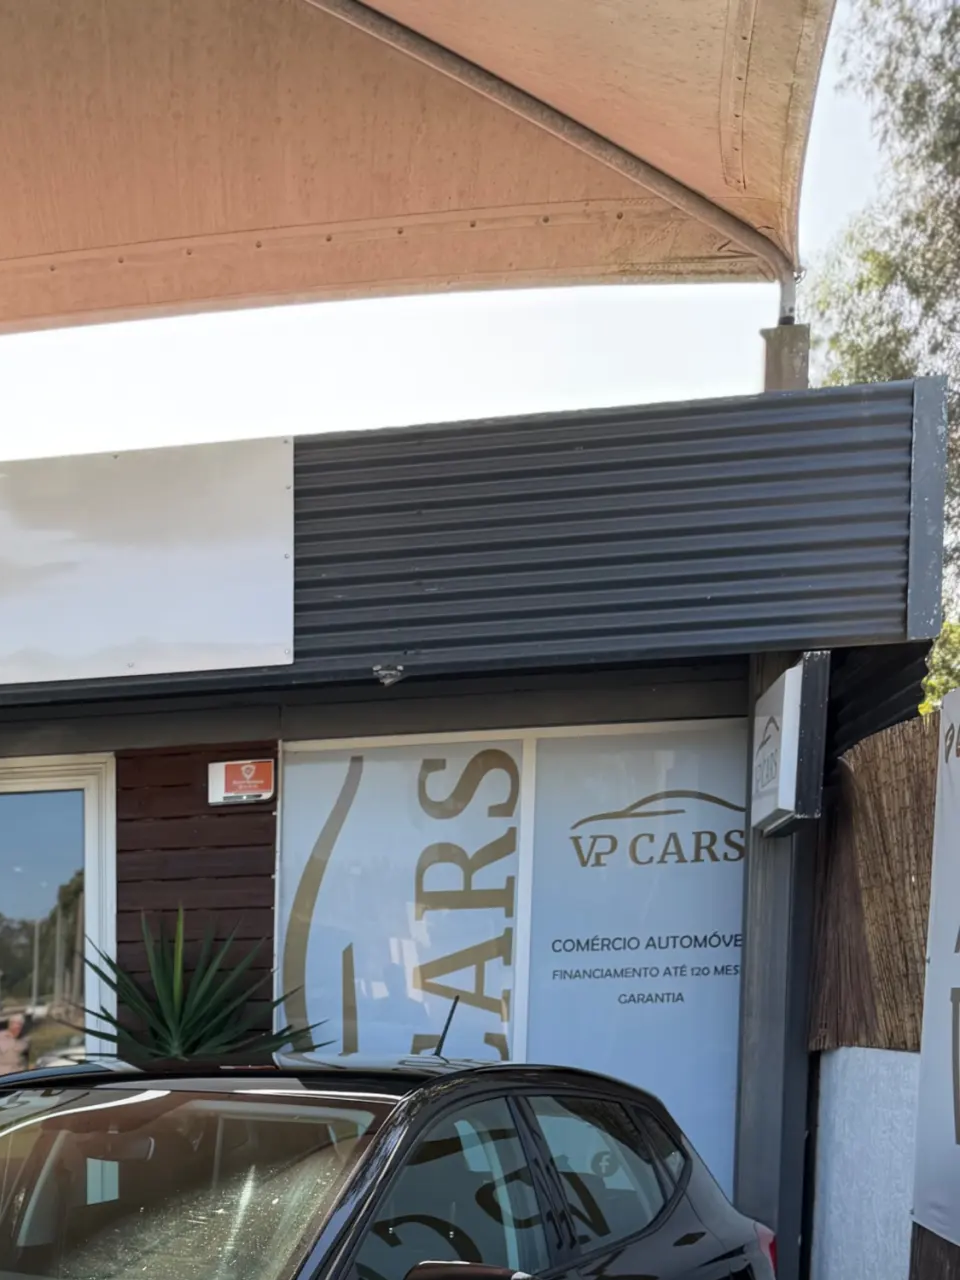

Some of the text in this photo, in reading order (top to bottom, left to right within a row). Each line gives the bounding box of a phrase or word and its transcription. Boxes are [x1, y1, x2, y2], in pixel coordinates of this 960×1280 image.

[568, 829, 746, 868] VP CARS
[551, 934, 640, 953] COMÉRCIO
[552, 966, 659, 980] FINANCIAMENTO
[663, 964, 687, 977] ATÉ
[691, 967, 710, 976] 120
[617, 992, 685, 1005] GARANTIA
